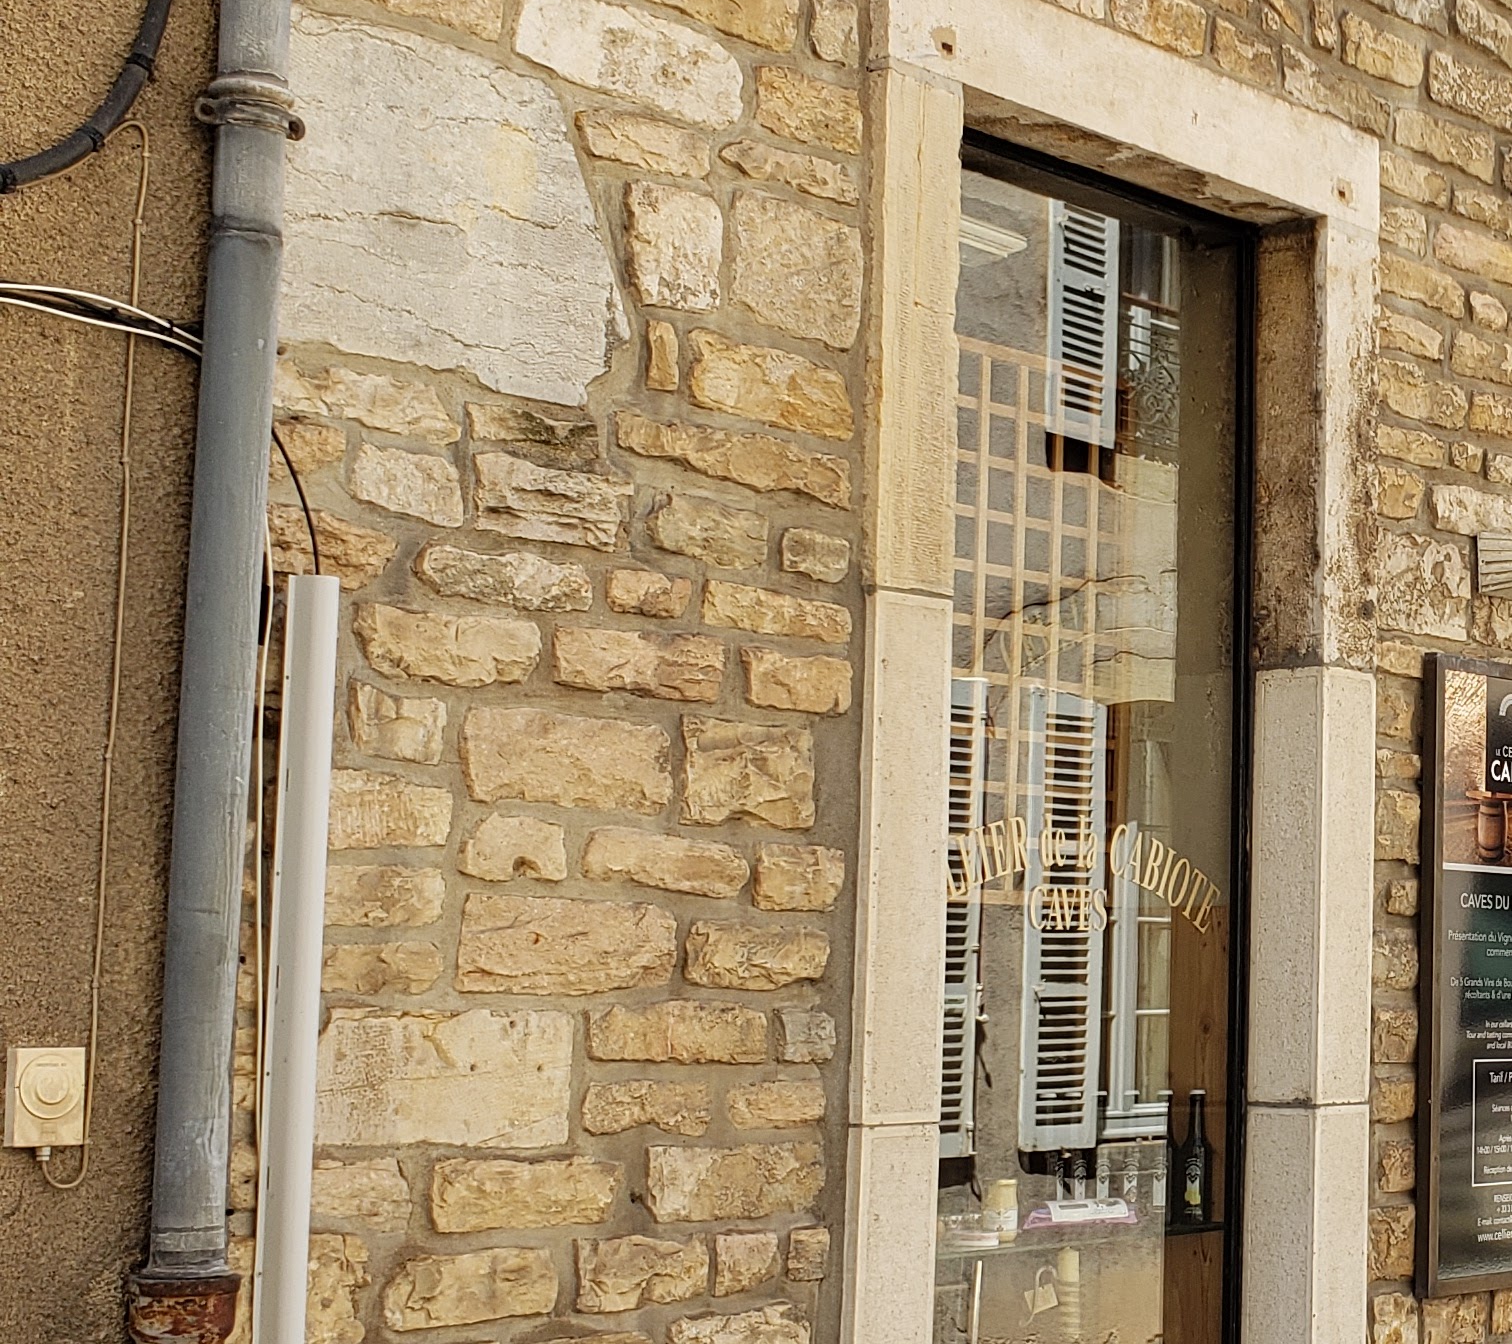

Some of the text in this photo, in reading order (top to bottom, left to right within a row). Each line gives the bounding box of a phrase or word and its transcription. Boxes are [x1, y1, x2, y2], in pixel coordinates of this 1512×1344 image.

[947, 814, 1221, 934] LLIER de la CABIOTE
[1030, 886, 1107, 931] CAVES
[1460, 892, 1493, 909] CAVES
[1495, 895, 1510, 910] DU
[1448, 929, 1487, 942] Présentation
[1488, 932, 1496, 942] du
[1464, 976, 1483, 987] Grands
[1489, 1071, 1504, 1083] Tarif
